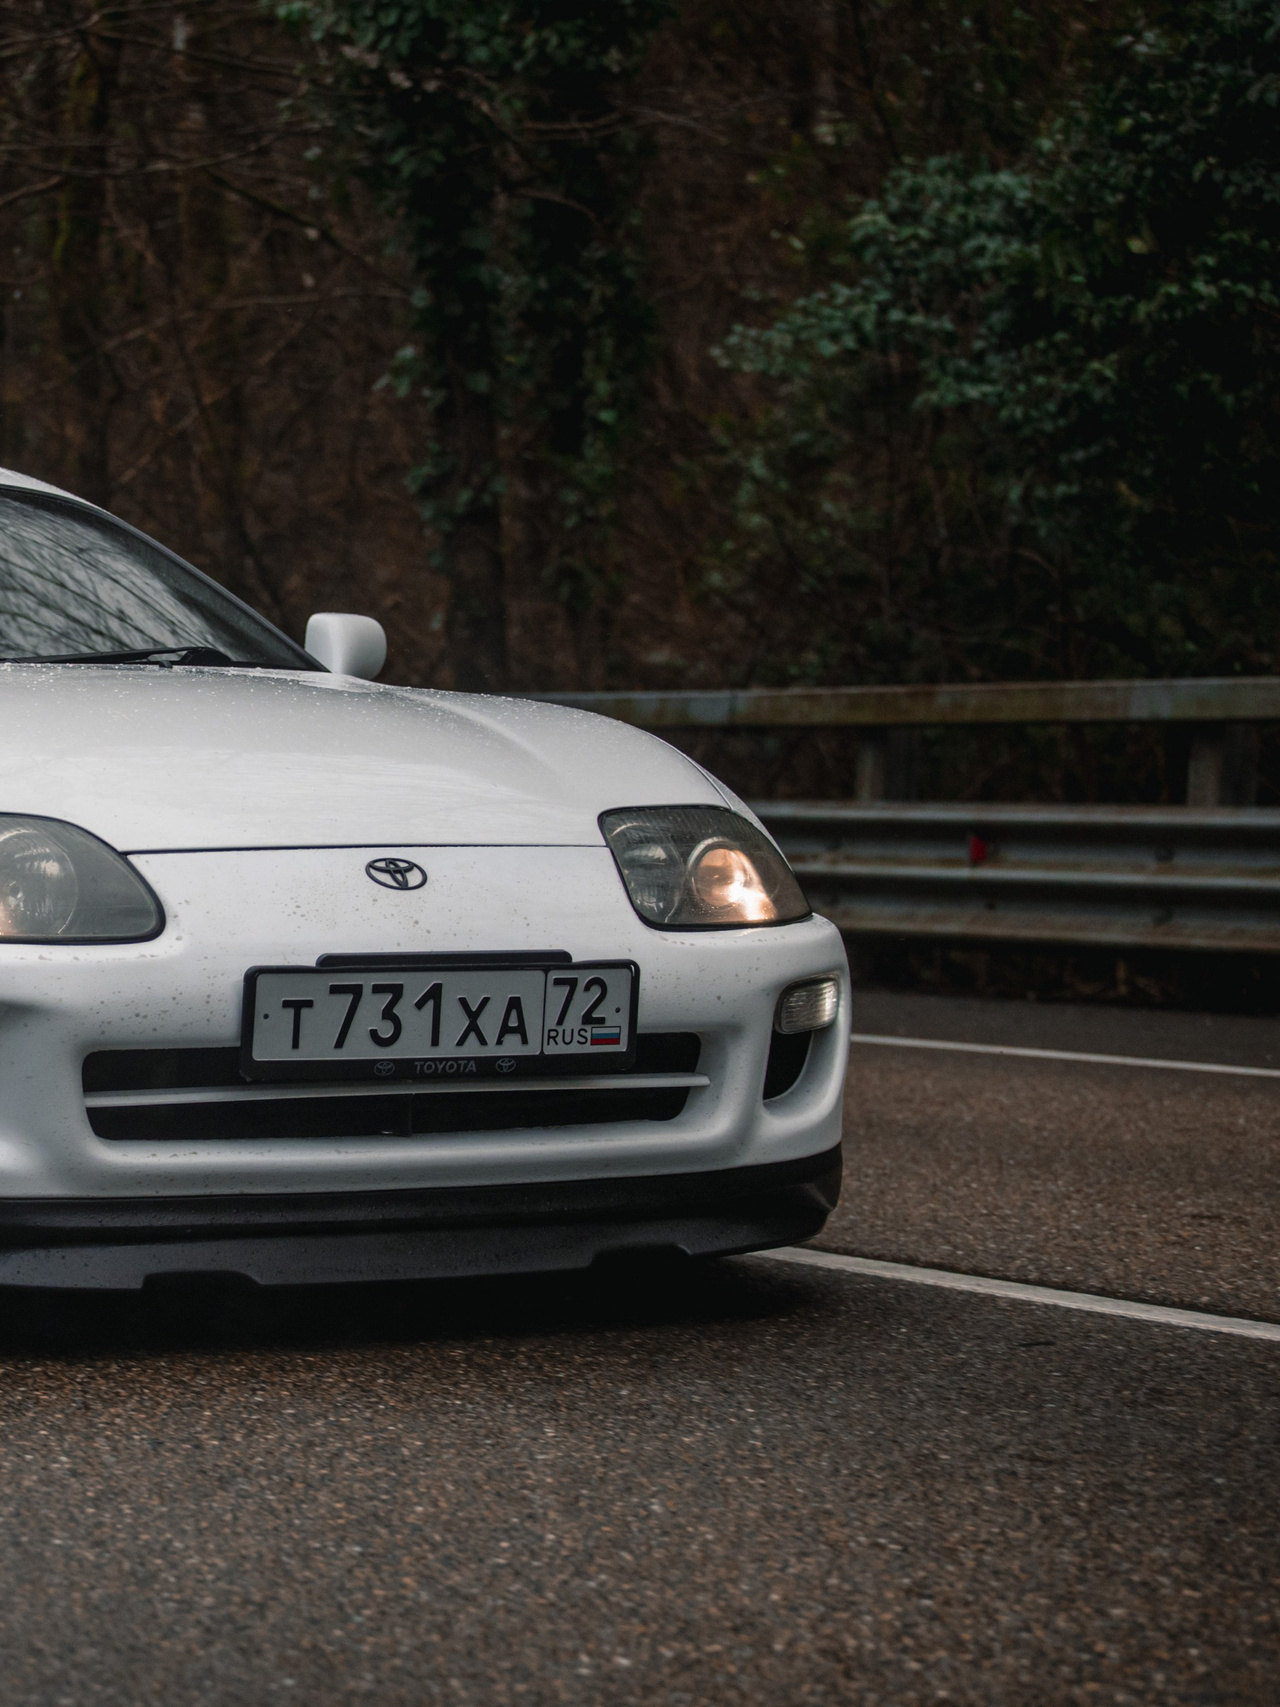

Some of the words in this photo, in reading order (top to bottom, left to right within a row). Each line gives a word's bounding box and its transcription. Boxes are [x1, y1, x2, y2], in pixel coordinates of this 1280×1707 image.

[553, 976, 608, 1026] 72
[546, 1028, 588, 1046] RUS
[414, 1060, 477, 1074] TOYOTA
